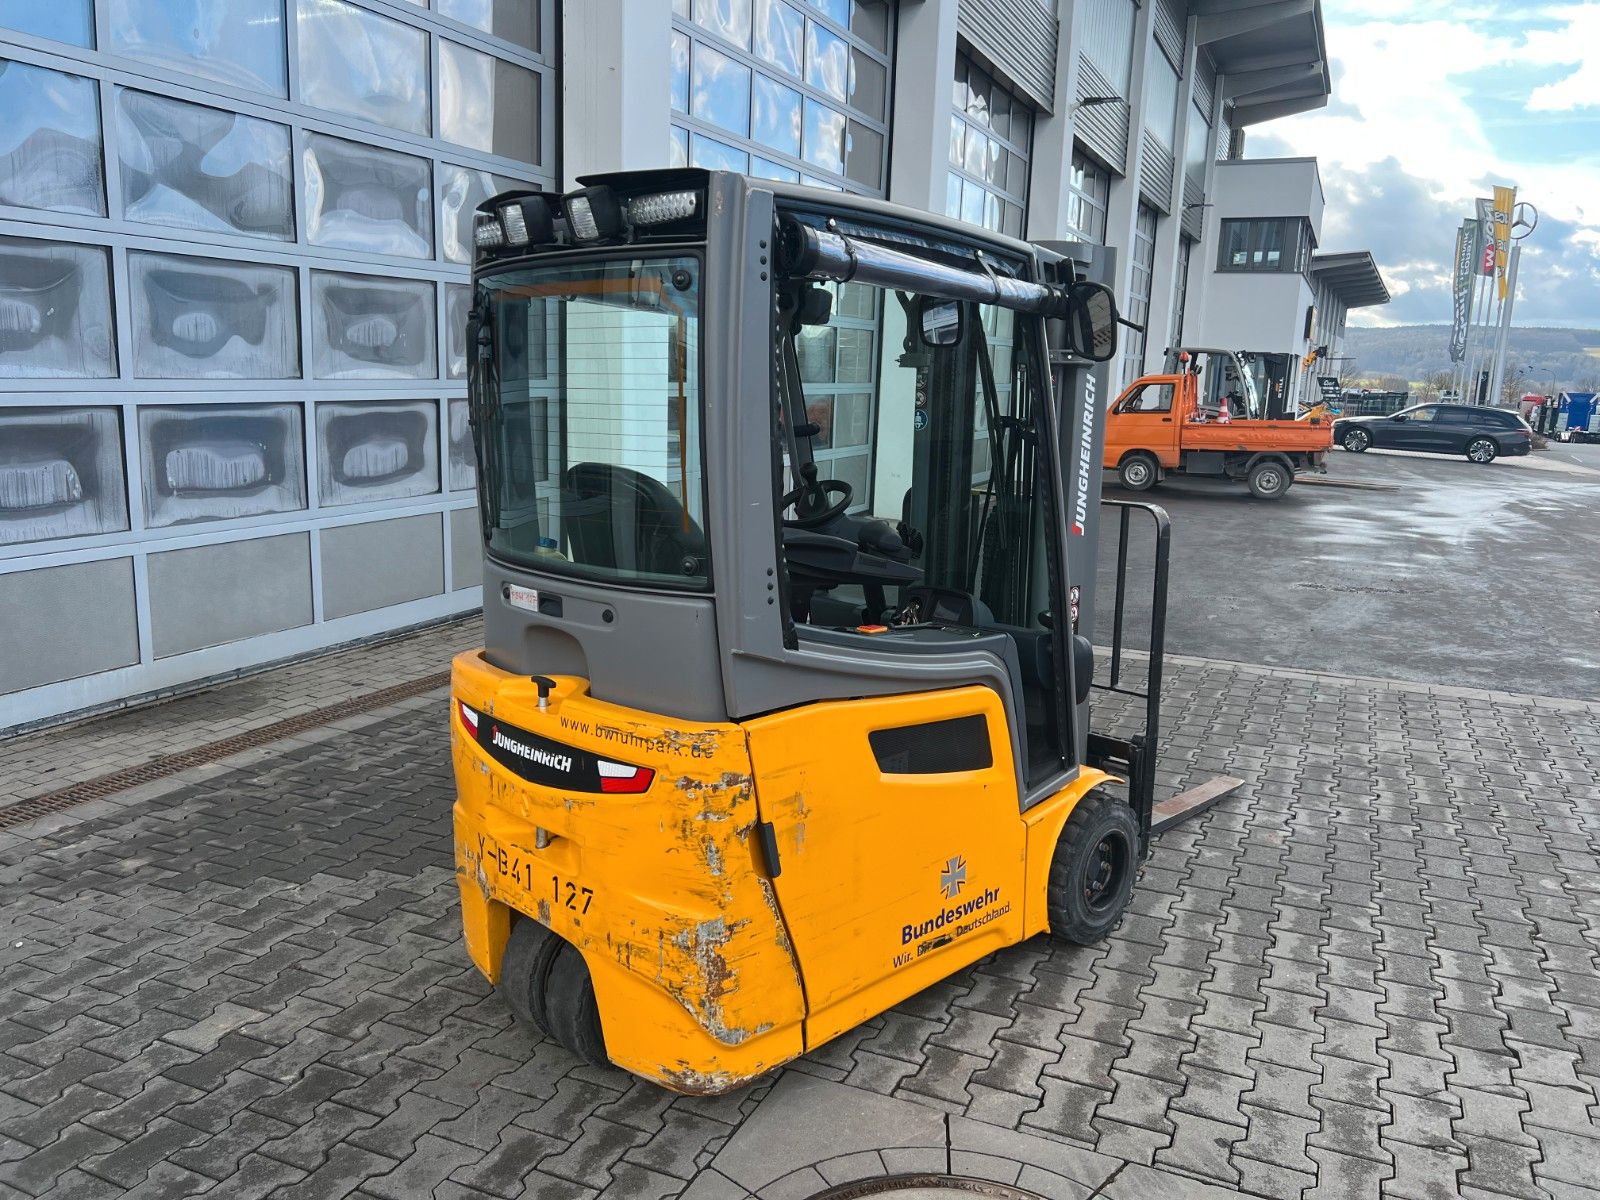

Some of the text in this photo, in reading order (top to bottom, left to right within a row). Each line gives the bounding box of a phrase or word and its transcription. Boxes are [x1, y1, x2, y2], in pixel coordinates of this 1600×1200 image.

[1071, 373, 1096, 536] JUNGHEINRICH
[492, 725, 572, 773] JUNGHEINRICH
[478, 832, 593, 915] Y-B41 127
[902, 888, 1000, 945] Bundeswehr
[893, 952, 913, 968] Wir.
